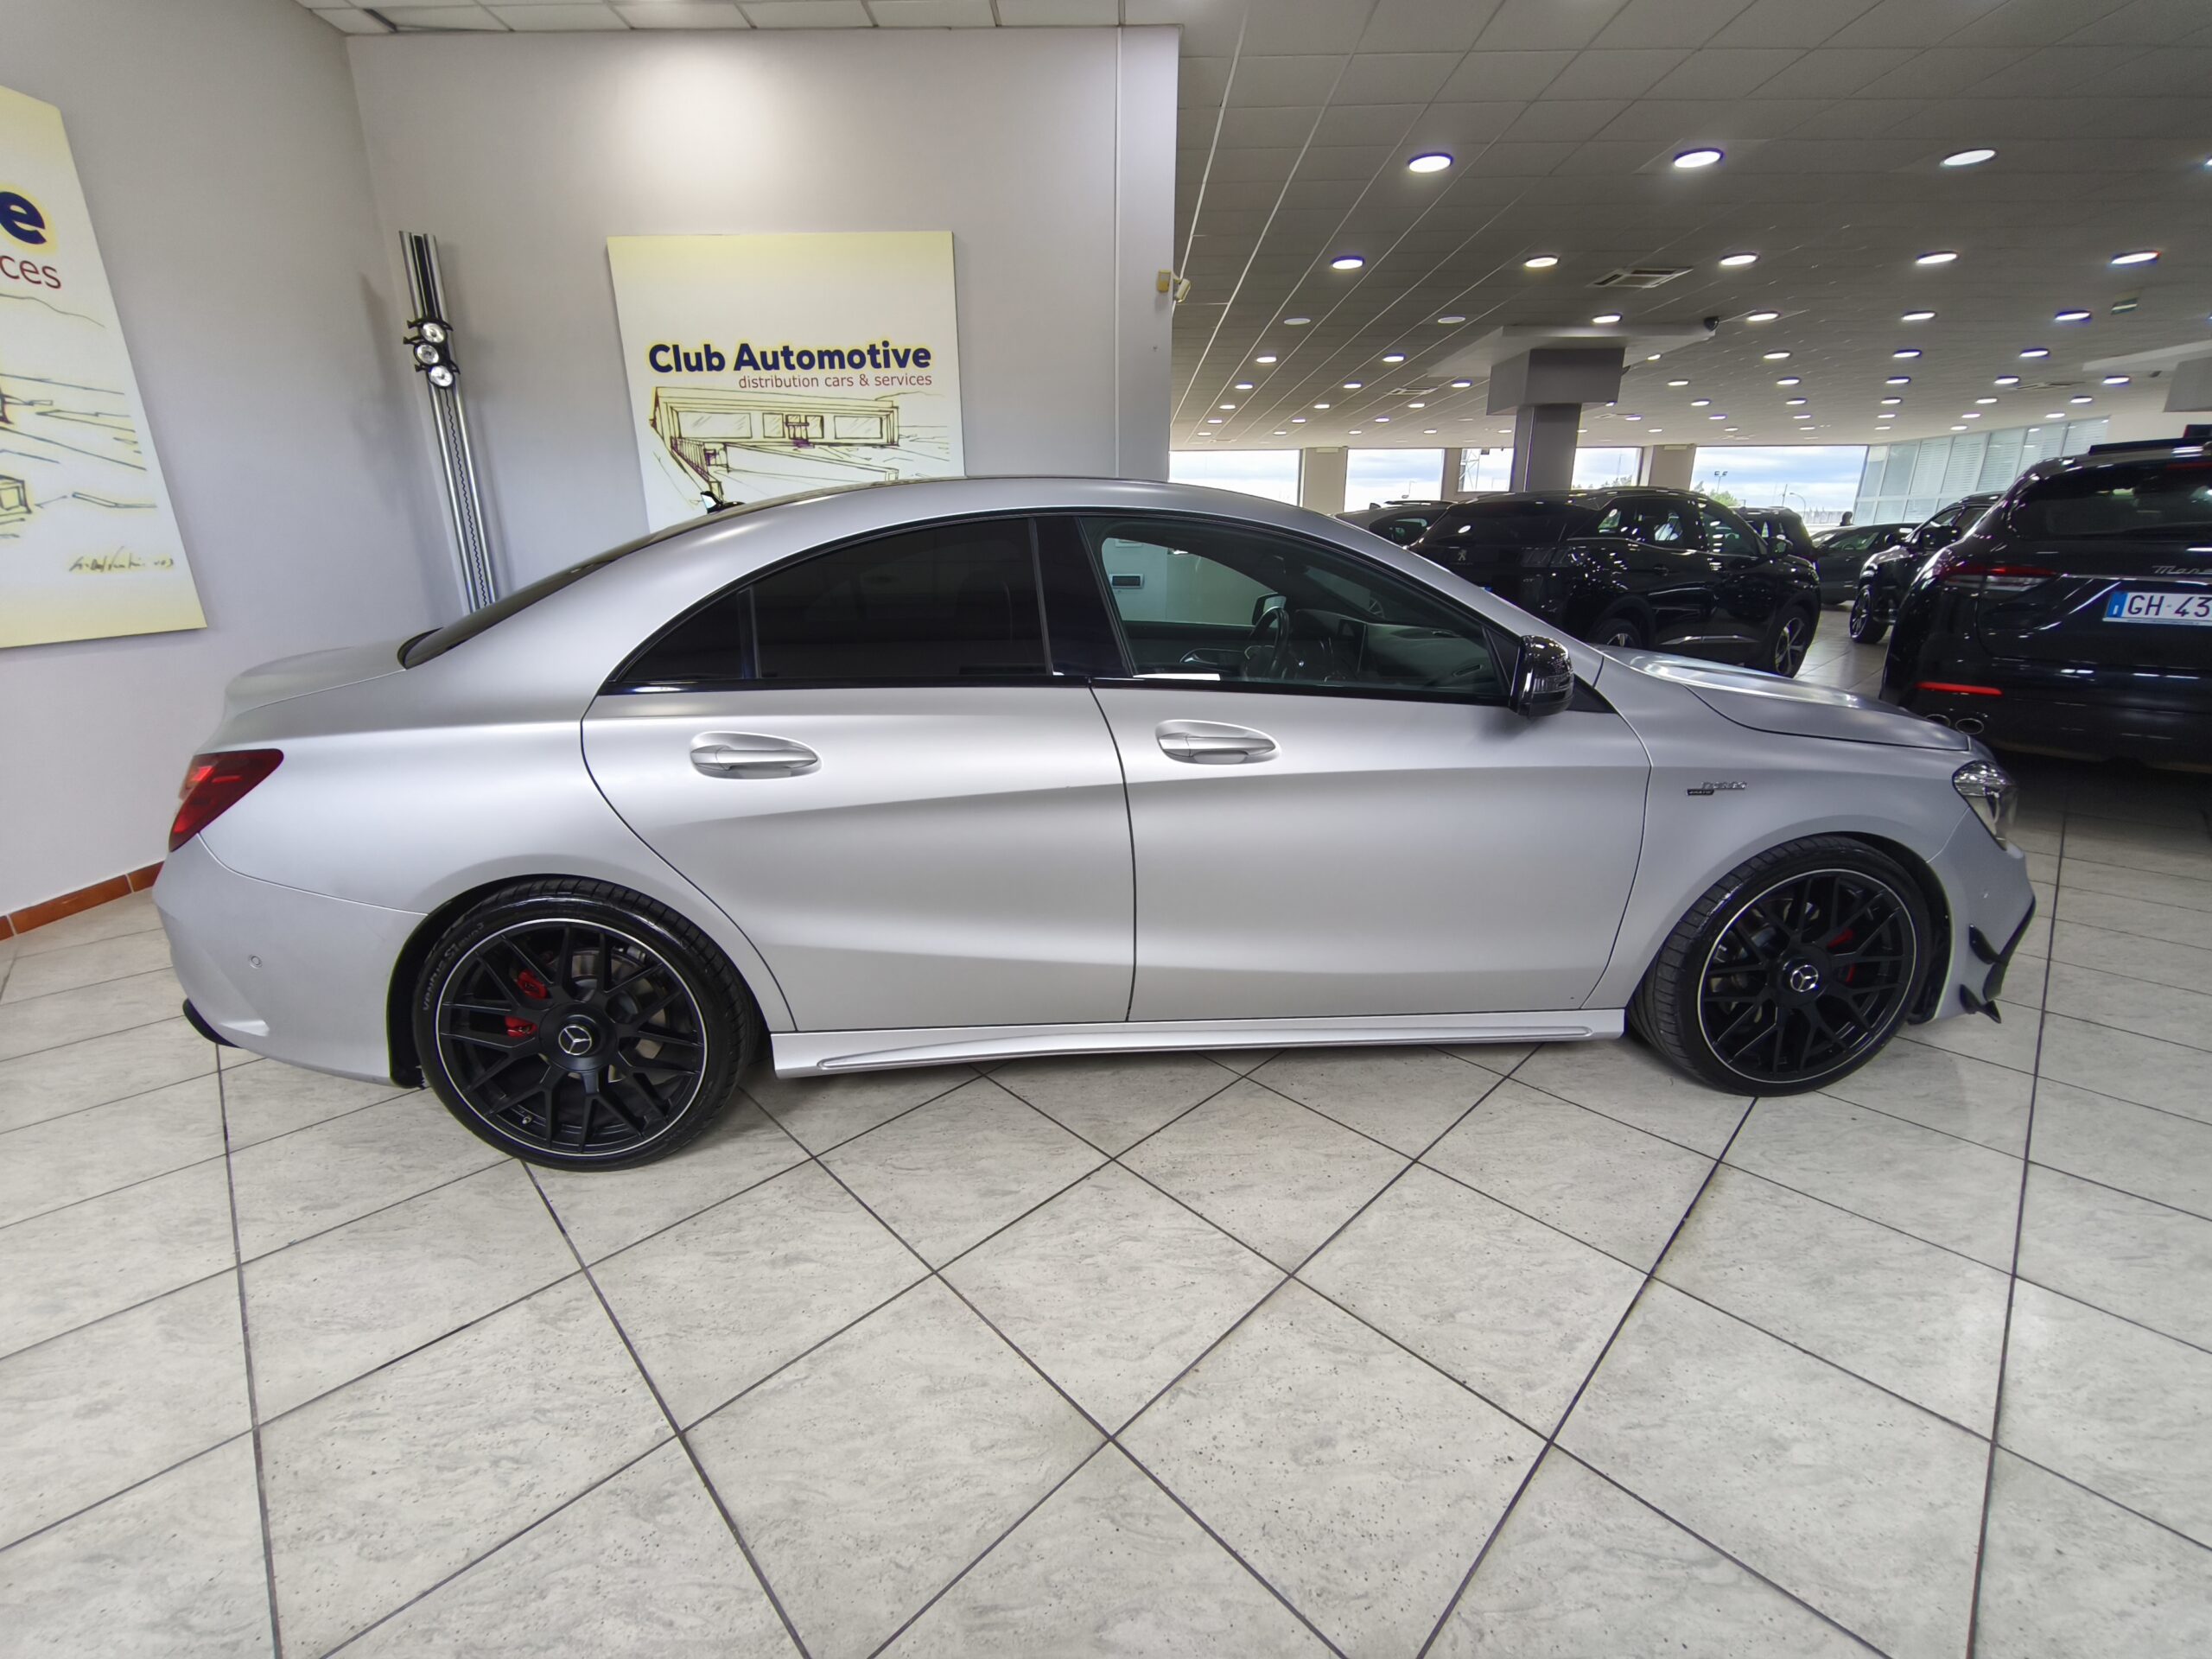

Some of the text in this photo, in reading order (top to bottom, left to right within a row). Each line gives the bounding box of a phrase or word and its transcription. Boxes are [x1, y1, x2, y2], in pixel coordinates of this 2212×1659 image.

[0, 255, 61, 289] ces
[649, 340, 931, 372] Club Automotive
[739, 373, 932, 389] distribution cars & services
[2127, 594, 2164, 616] GH
